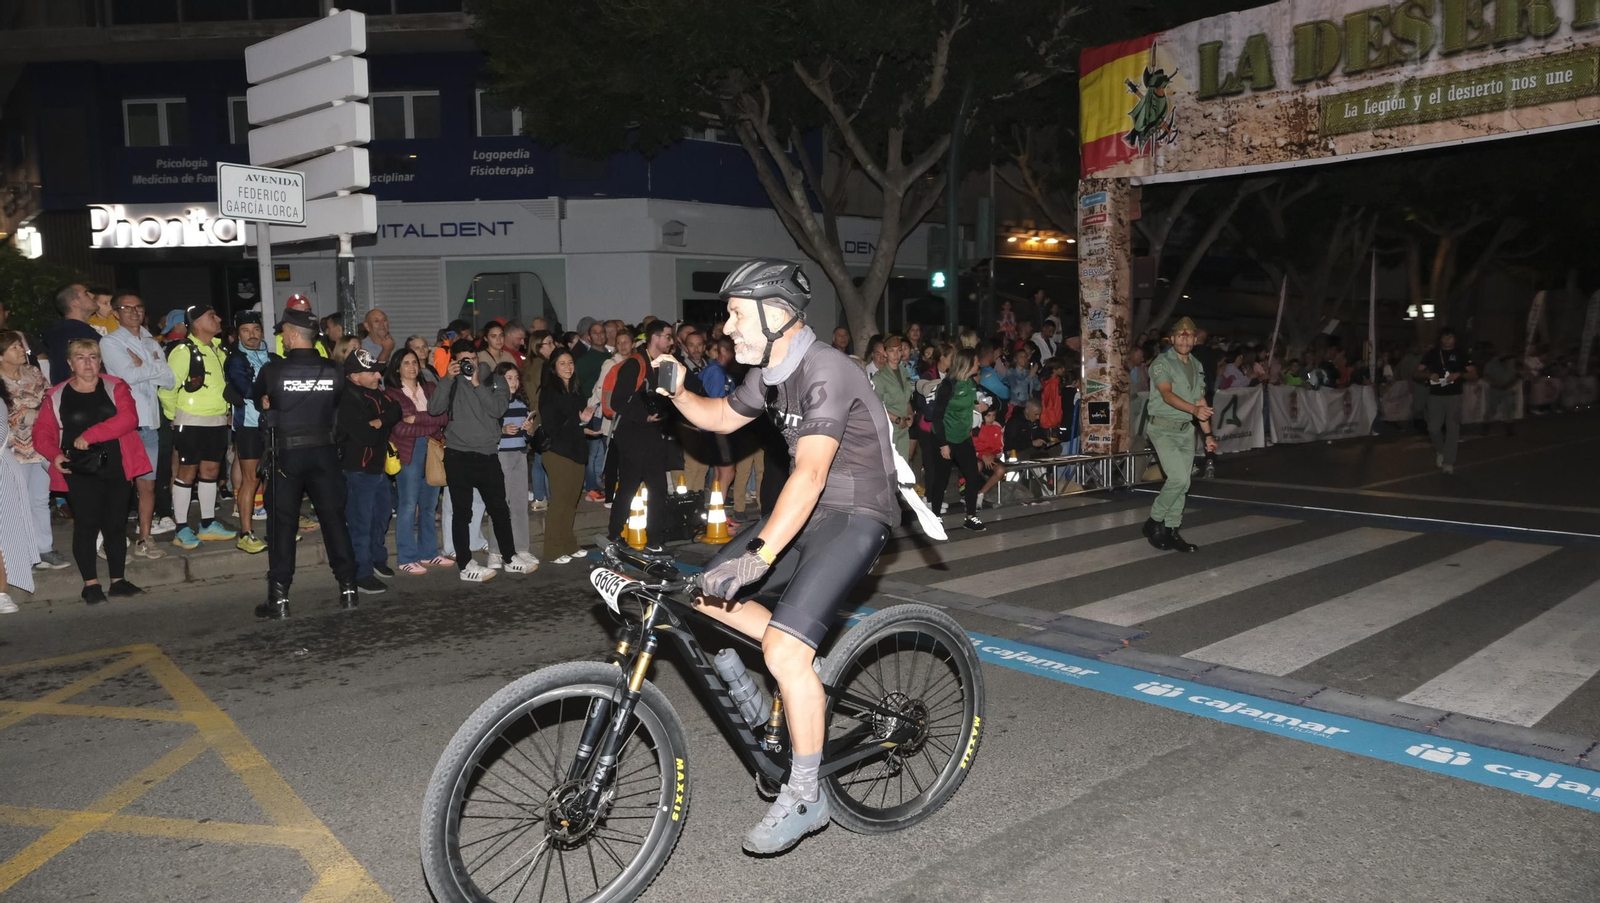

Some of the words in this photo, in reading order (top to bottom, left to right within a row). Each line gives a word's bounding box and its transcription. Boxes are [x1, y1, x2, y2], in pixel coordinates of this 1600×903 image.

[1198, 33, 1276, 99] LA
[1344, 103, 1358, 119] La
[1364, 93, 1406, 116] Legión
[1413, 94, 1422, 111] y
[1430, 87, 1441, 105] el
[1448, 79, 1503, 103] desierto
[1512, 74, 1537, 91] nos
[1546, 69, 1573, 86] une
[156, 158, 208, 170] Psicología
[473, 149, 530, 162] Logopedia
[132, 174, 179, 184] Medicina
[181, 174, 194, 183] de
[196, 173, 217, 183] Fam
[370, 172, 415, 184] isciplinar
[470, 165, 534, 177] Fisioterapia
[245, 174, 299, 187] AVENIDA
[238, 187, 286, 202] FEDERICO
[226, 200, 264, 214] GARCÍA
[267, 204, 299, 218] LORCA
[88, 203, 245, 248] Phonika
[377, 221, 514, 238] ITALDENT
[800, 421, 834, 431] COTT
[595, 570, 626, 597] 6605
[981, 646, 1100, 675] cajamar
[1188, 696, 1350, 734] cajamar
[1253, 717, 1285, 728] CAJA
[1289, 725, 1334, 740] RURAL
[960, 715, 981, 769] MAXXIS
[671, 758, 685, 821] MAXXIS
